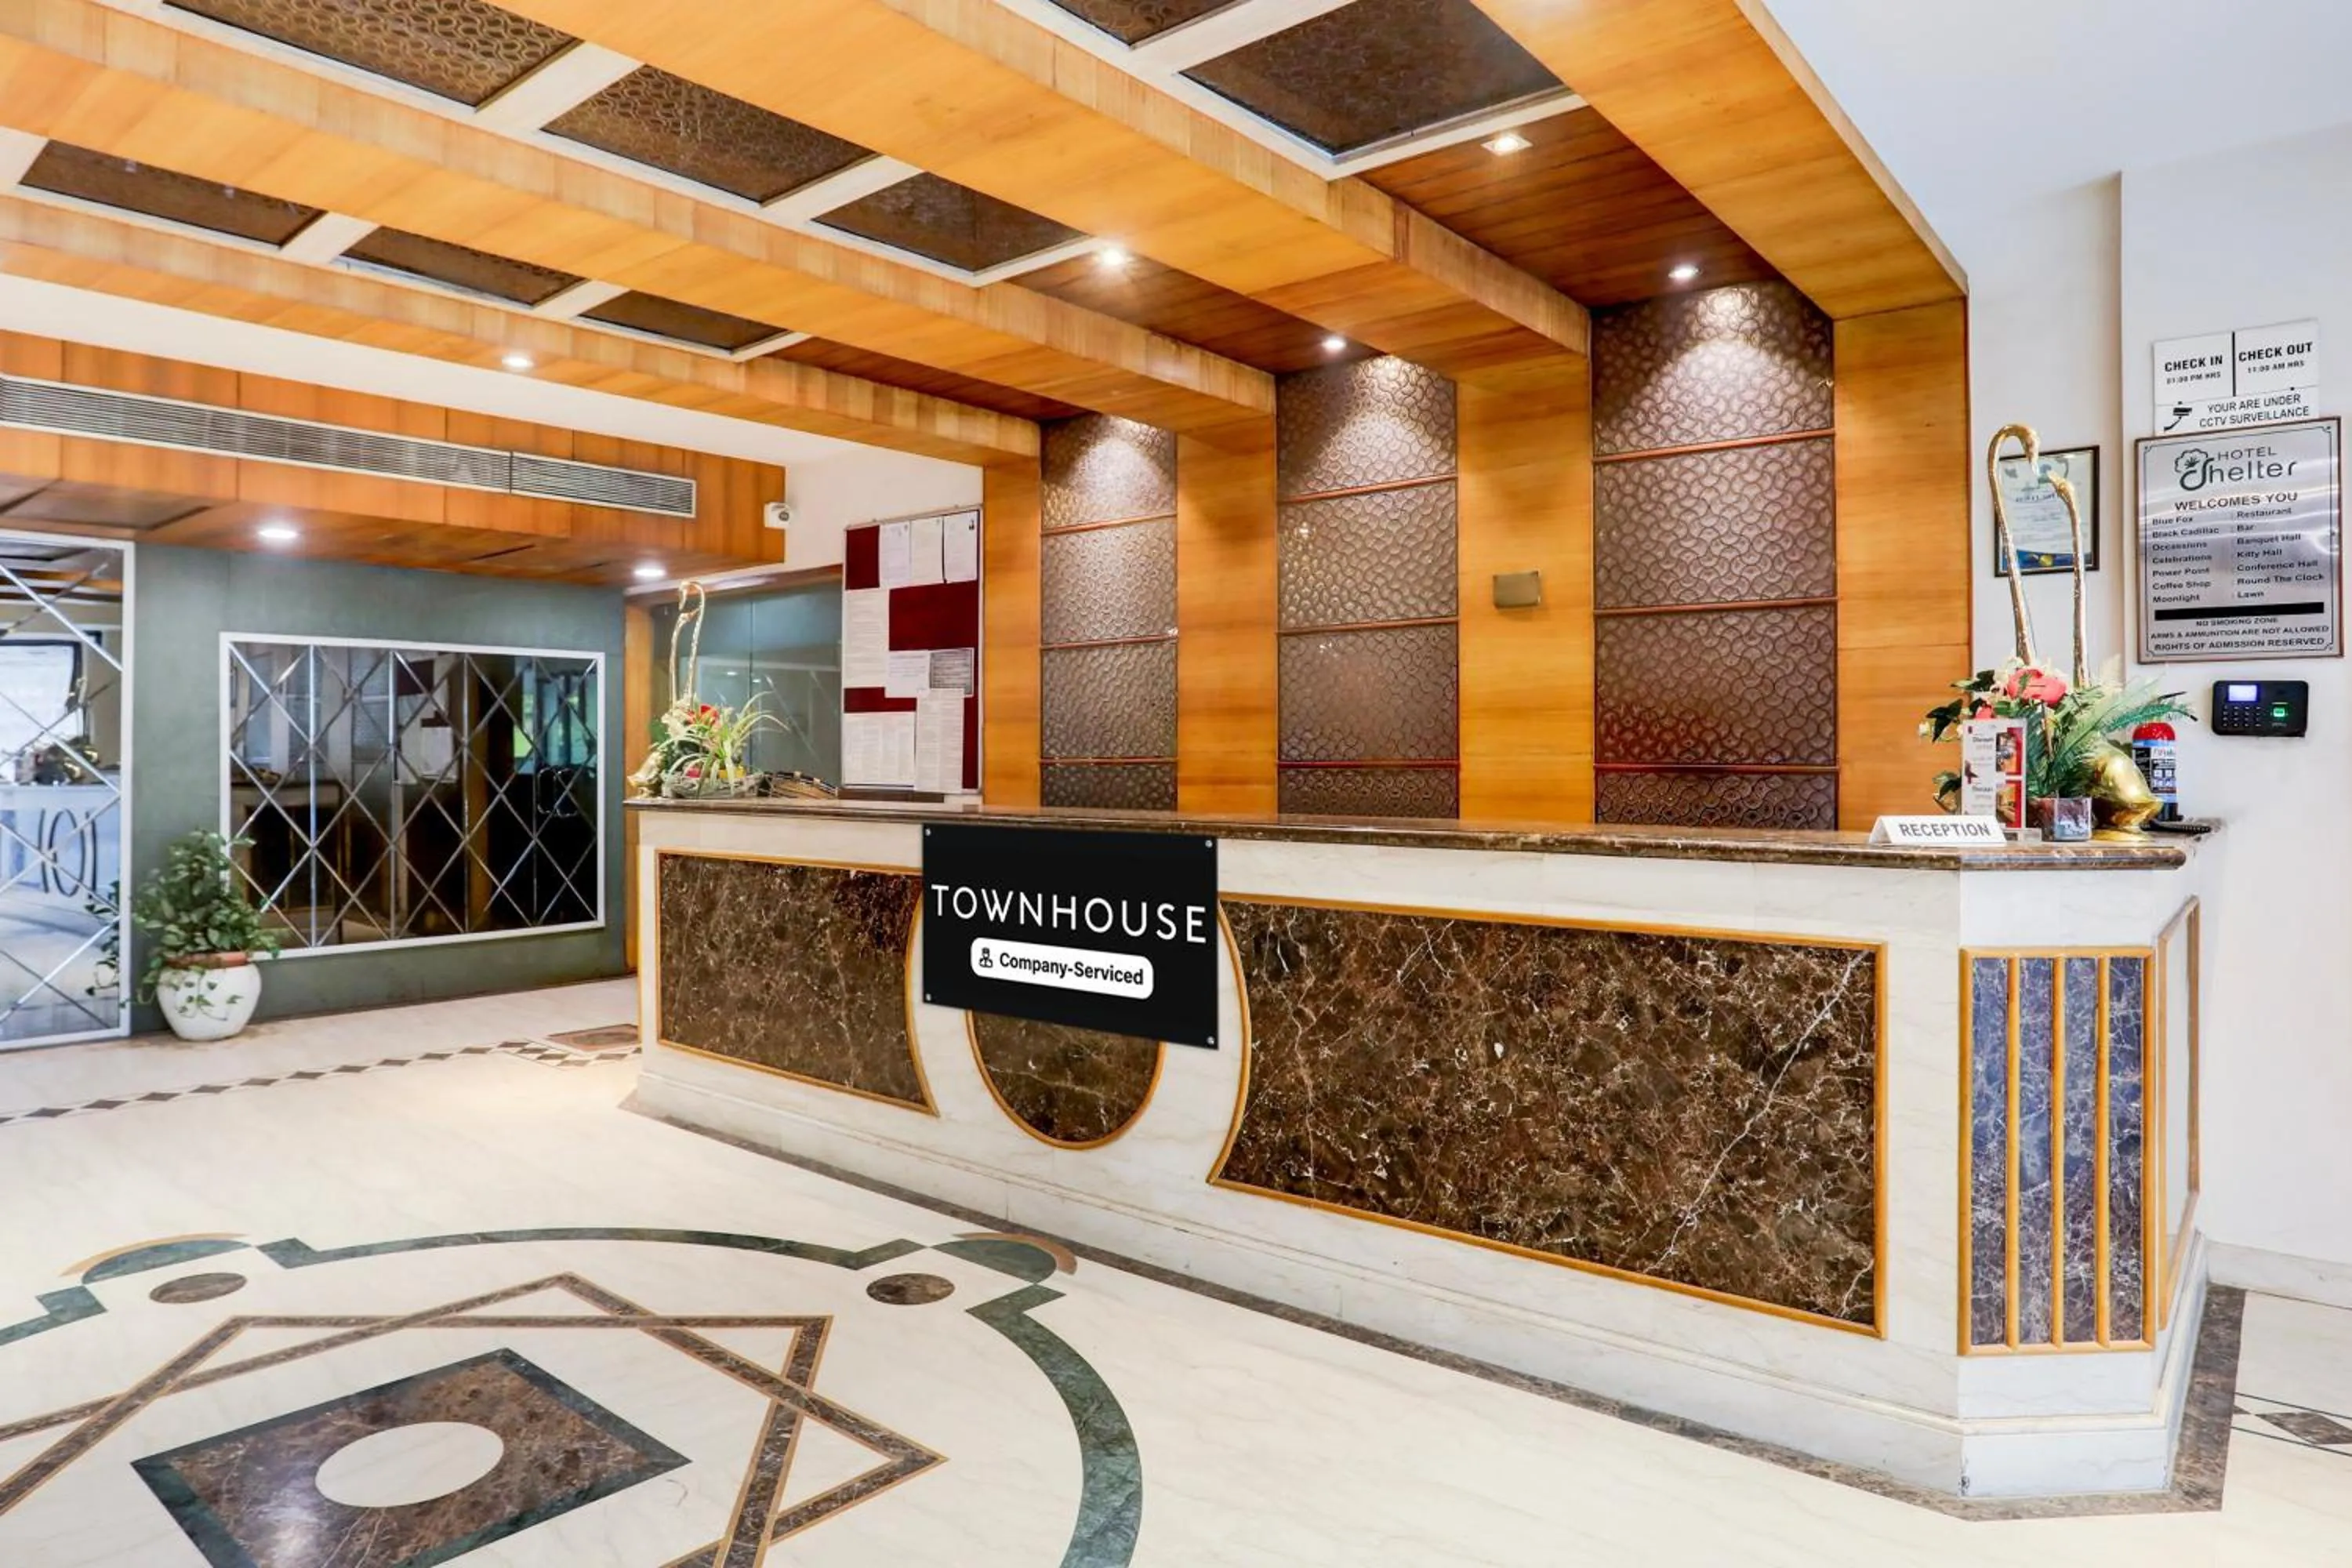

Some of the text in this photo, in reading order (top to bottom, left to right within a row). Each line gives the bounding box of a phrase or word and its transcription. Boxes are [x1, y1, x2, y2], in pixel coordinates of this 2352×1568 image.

[2238, 342, 2313, 363] CHECK OUT
[2165, 354, 2223, 372] CHECK IN
[2190, 373, 2203, 382] PM
[2208, 394, 2301, 413] YOUR ARE UNDER
[2199, 406, 2309, 427] CCTV SURVEILLANCE
[2218, 447, 2278, 460] HOTEL
[2180, 457, 2297, 491] Shelter
[2175, 492, 2298, 510] WELCOMES YOU
[2237, 508, 2292, 518] Restaurant
[2152, 529, 2178, 539] Black
[2237, 535, 2279, 545] Banquet
[2152, 554, 2212, 564] Celebrations
[2237, 562, 2295, 572] Conference
[2152, 581, 2183, 590] Coffee
[2152, 594, 2201, 603] Moonlight
[2185, 629, 2240, 637] AMMUNITION
[2154, 641, 2190, 651] RIGHTS
[2209, 639, 2265, 648] ADMISSION
[2267, 637, 2325, 647] RESERVED
[1899, 823, 1991, 837] RECEPTION
[931, 884, 1207, 944] TOWNHOUSE
[999, 951, 1145, 986] Company-Serviced
